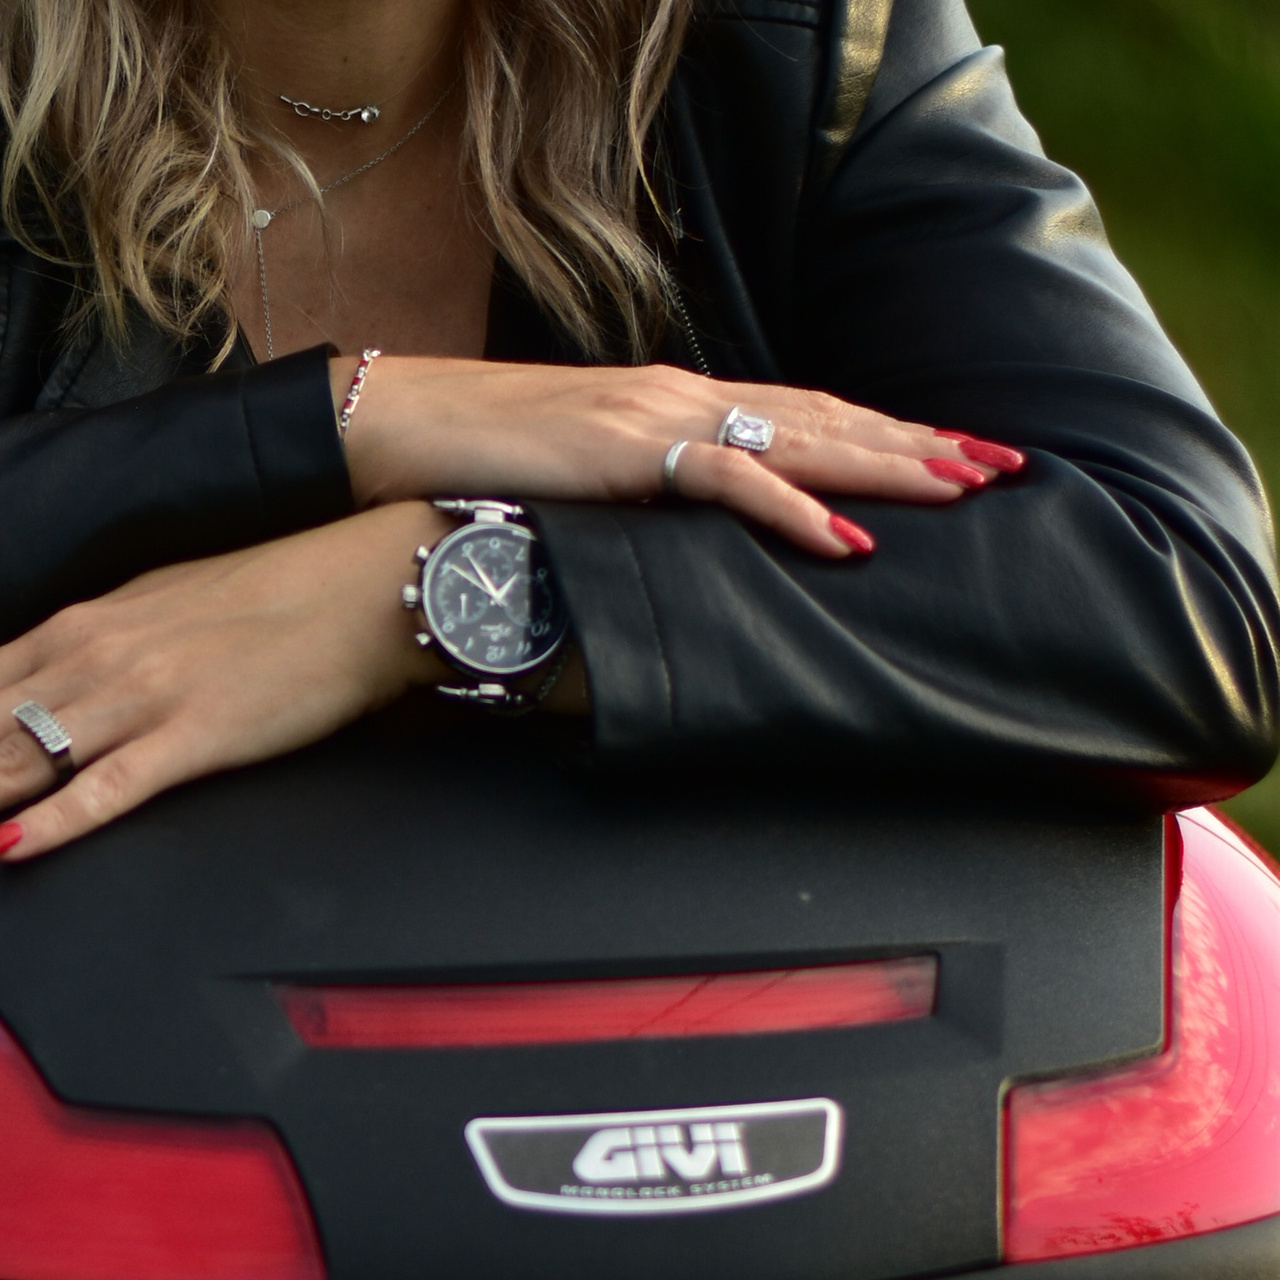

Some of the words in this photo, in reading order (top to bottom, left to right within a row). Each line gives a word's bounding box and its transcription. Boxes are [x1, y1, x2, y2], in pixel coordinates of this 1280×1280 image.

[573, 1122, 748, 1182] GIVI
[560, 1184, 682, 1199] MONOLOCK
[690, 1173, 775, 1196] SYSTEM
